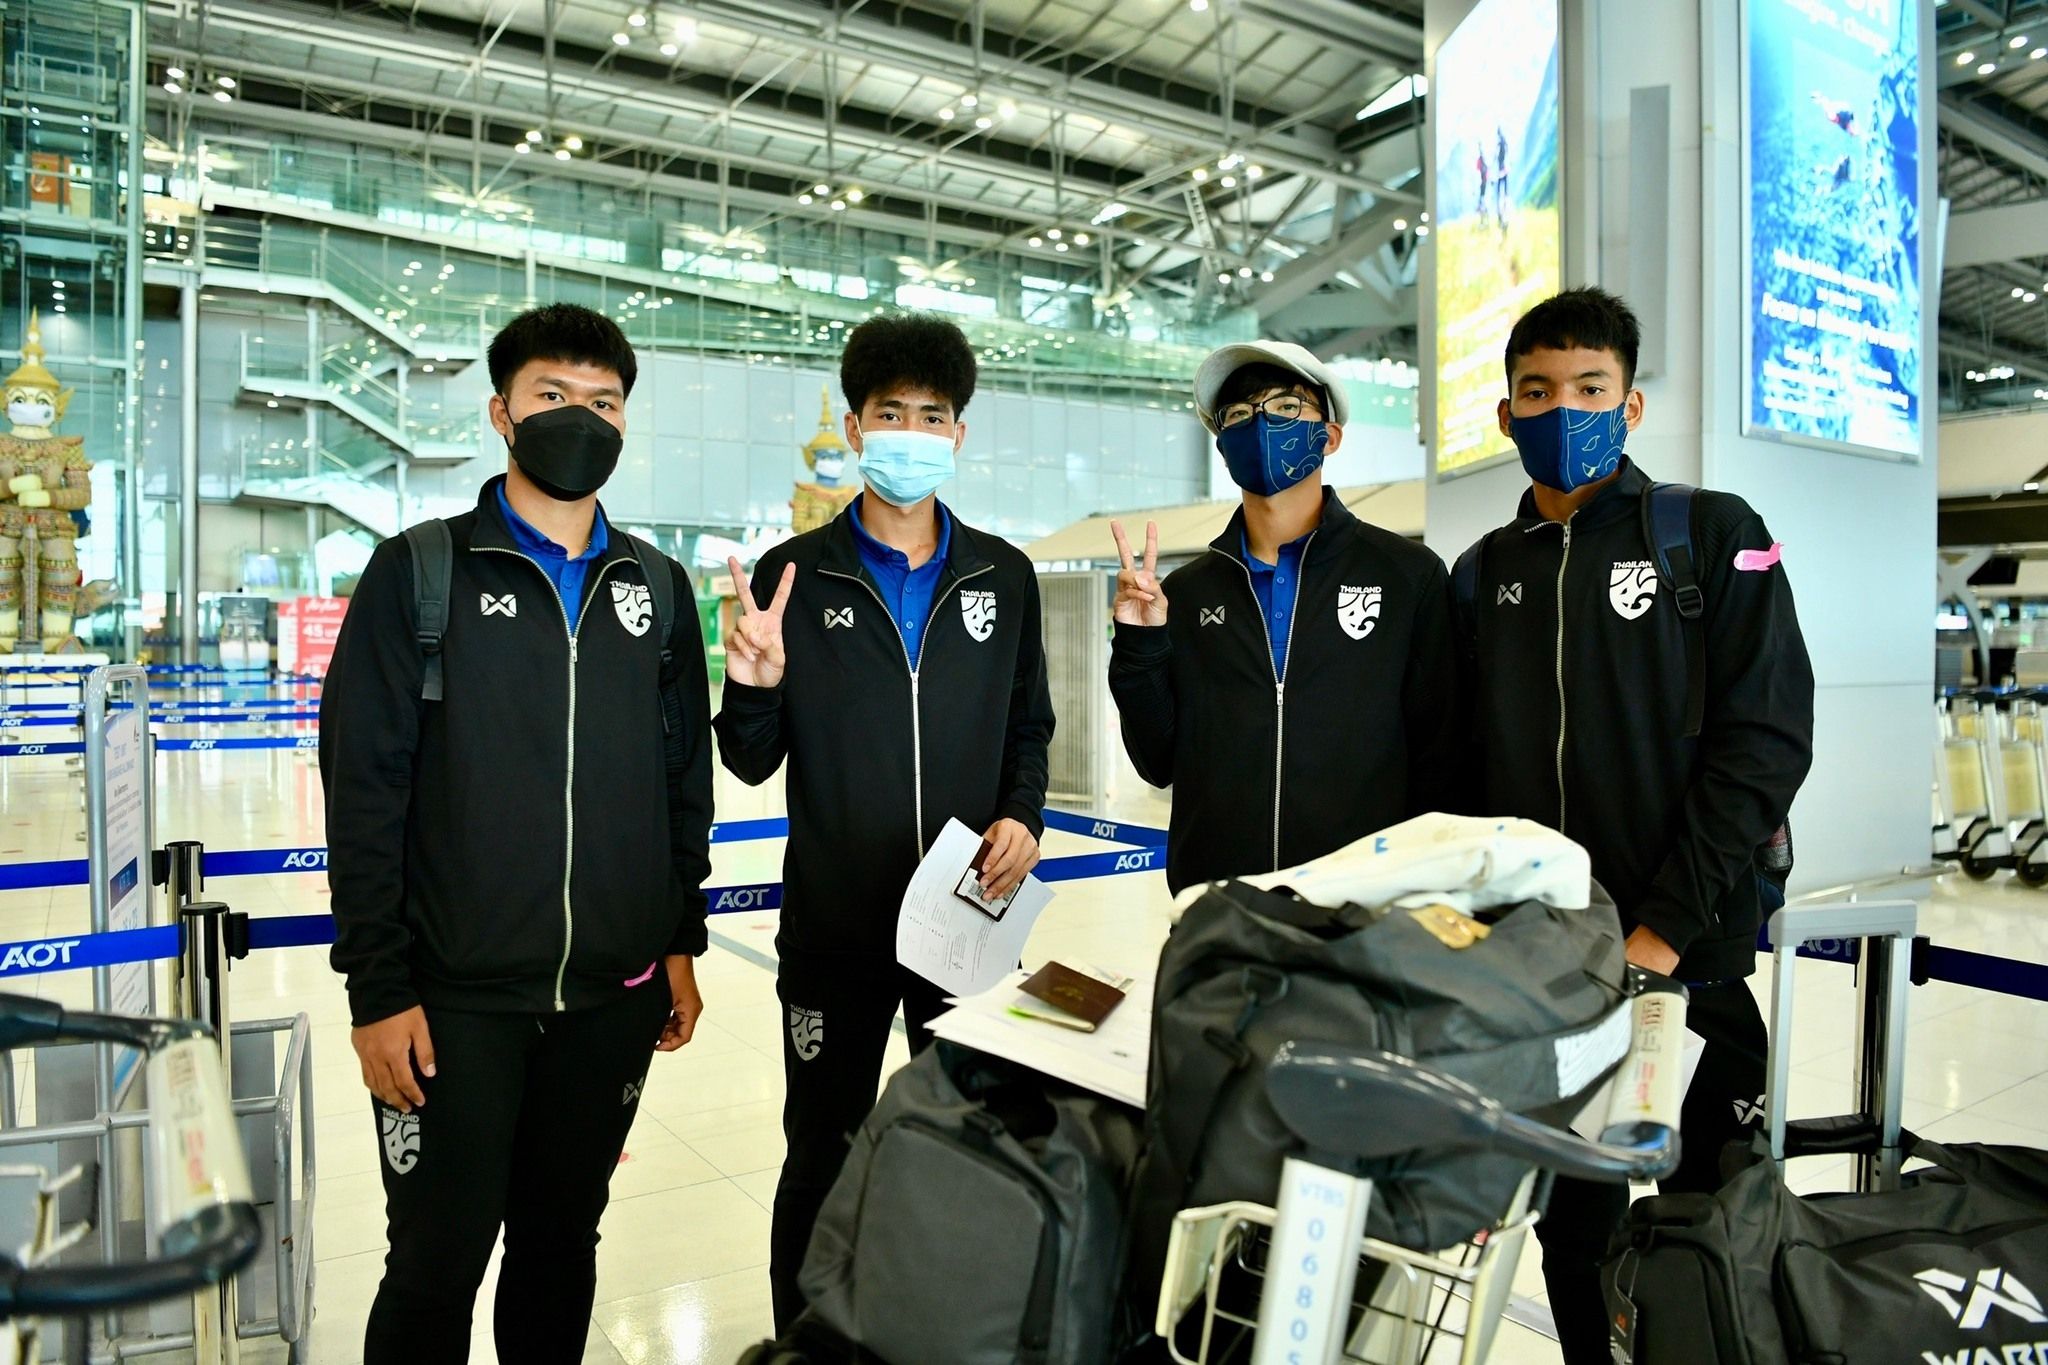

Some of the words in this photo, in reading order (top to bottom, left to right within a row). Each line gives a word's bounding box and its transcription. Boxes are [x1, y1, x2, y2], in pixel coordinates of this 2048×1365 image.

[1613, 561, 1653, 569] THAILAN
[609, 581, 648, 592] THAILAND
[1340, 585, 1382, 594] THAILAND
[960, 590, 996, 598] THAILAND
[1, 719, 23, 728] AOT
[18, 745, 47, 755] AOT
[189, 740, 217, 750] AOT
[1092, 821, 1117, 838] AOT
[282, 851, 328, 868] AOT
[1114, 851, 1155, 870] AOT
[715, 888, 770, 910] AOT
[0, 940, 80, 971] AOT
[790, 1004, 823, 1018] THAILAND
